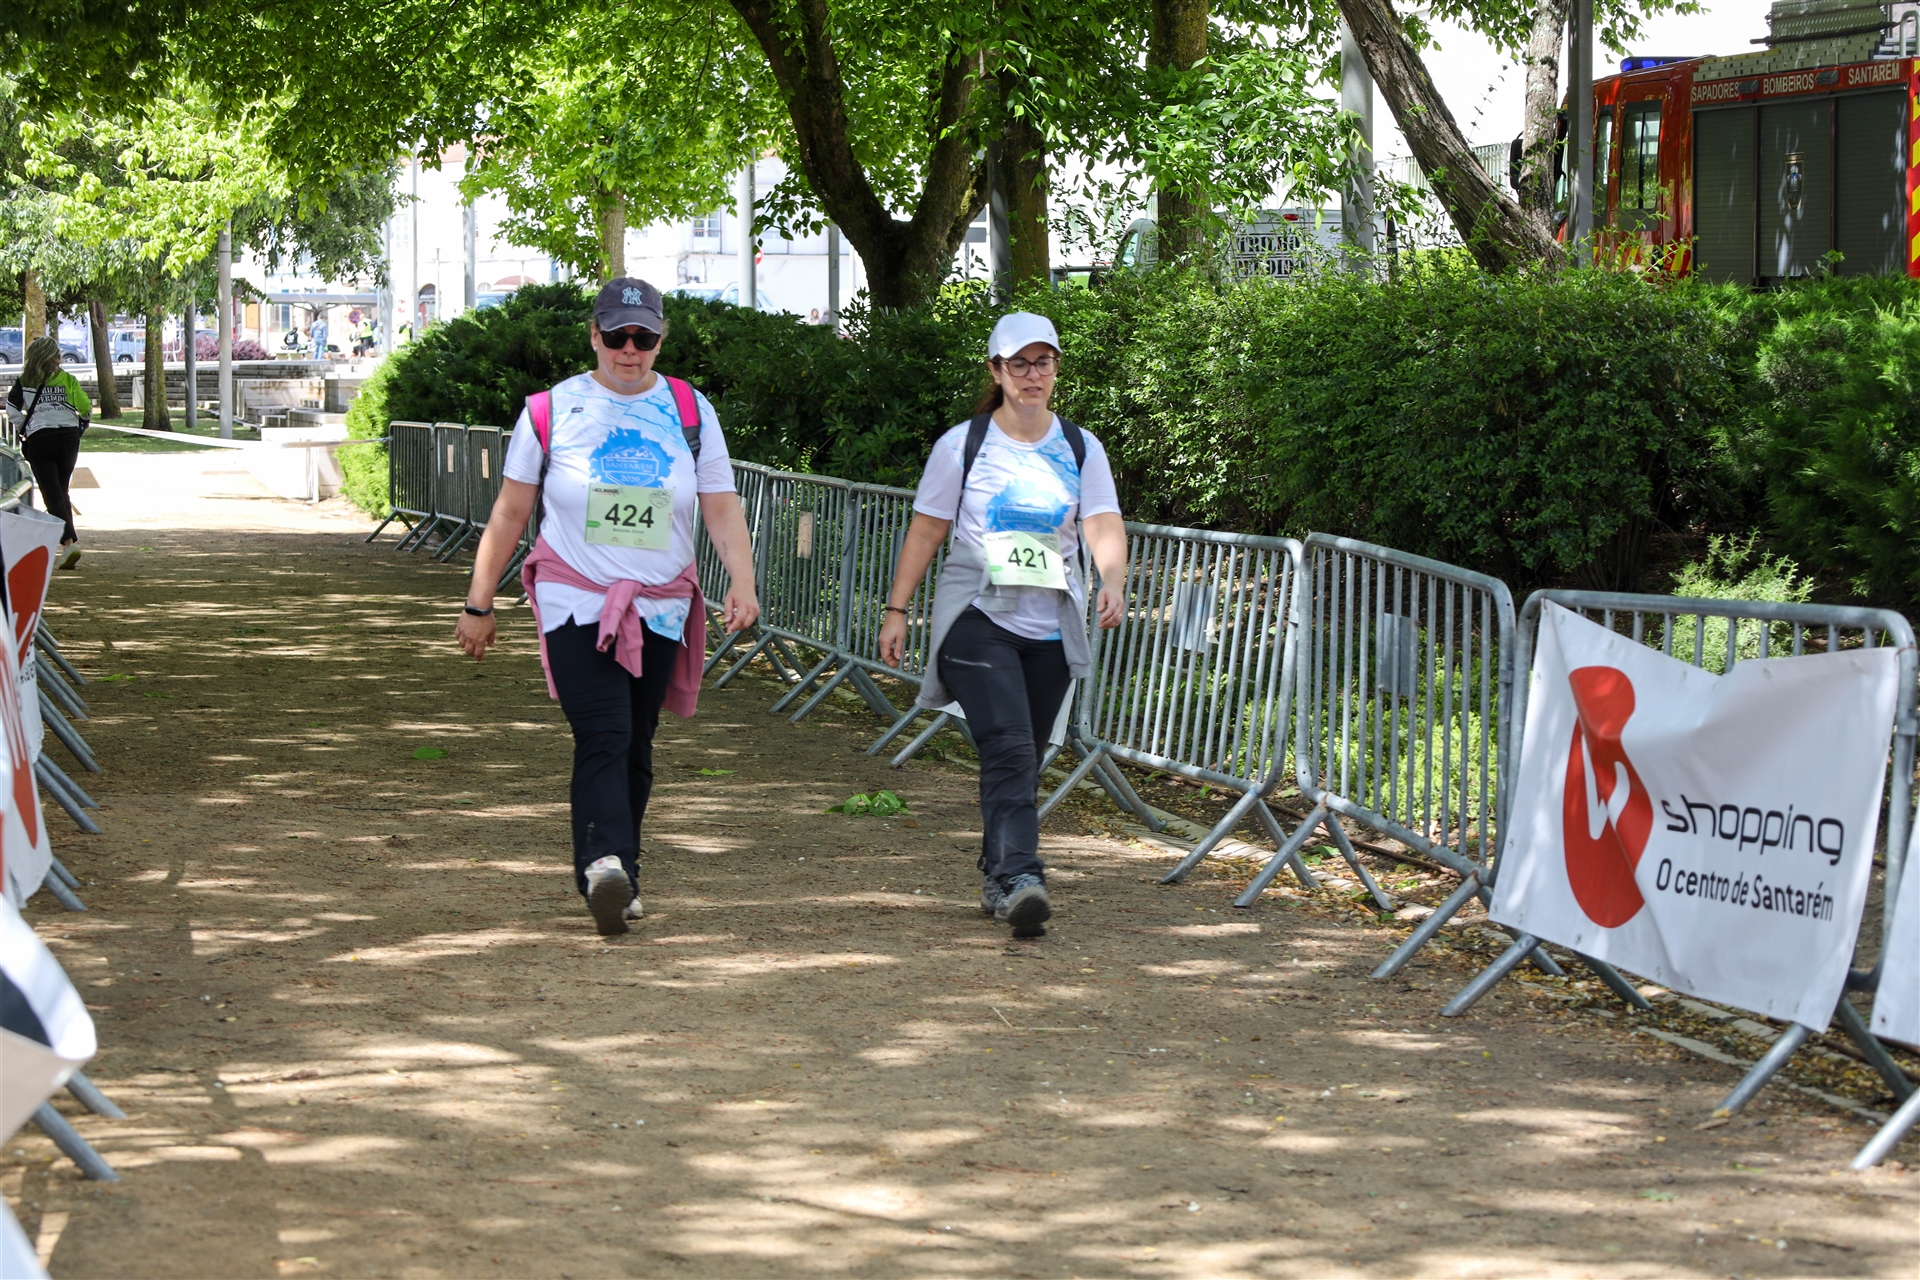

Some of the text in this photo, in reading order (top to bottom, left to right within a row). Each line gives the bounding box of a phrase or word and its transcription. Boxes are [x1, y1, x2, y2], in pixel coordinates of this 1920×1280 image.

[1691, 81, 1740, 102] SAPADORES
[1763, 73, 1814, 95] BOMBEIROS
[605, 503, 654, 528] 424
[1008, 547, 1048, 569] 421
[1661, 794, 1844, 866] shopping
[1656, 858, 1834, 921] O centro de Santarém
